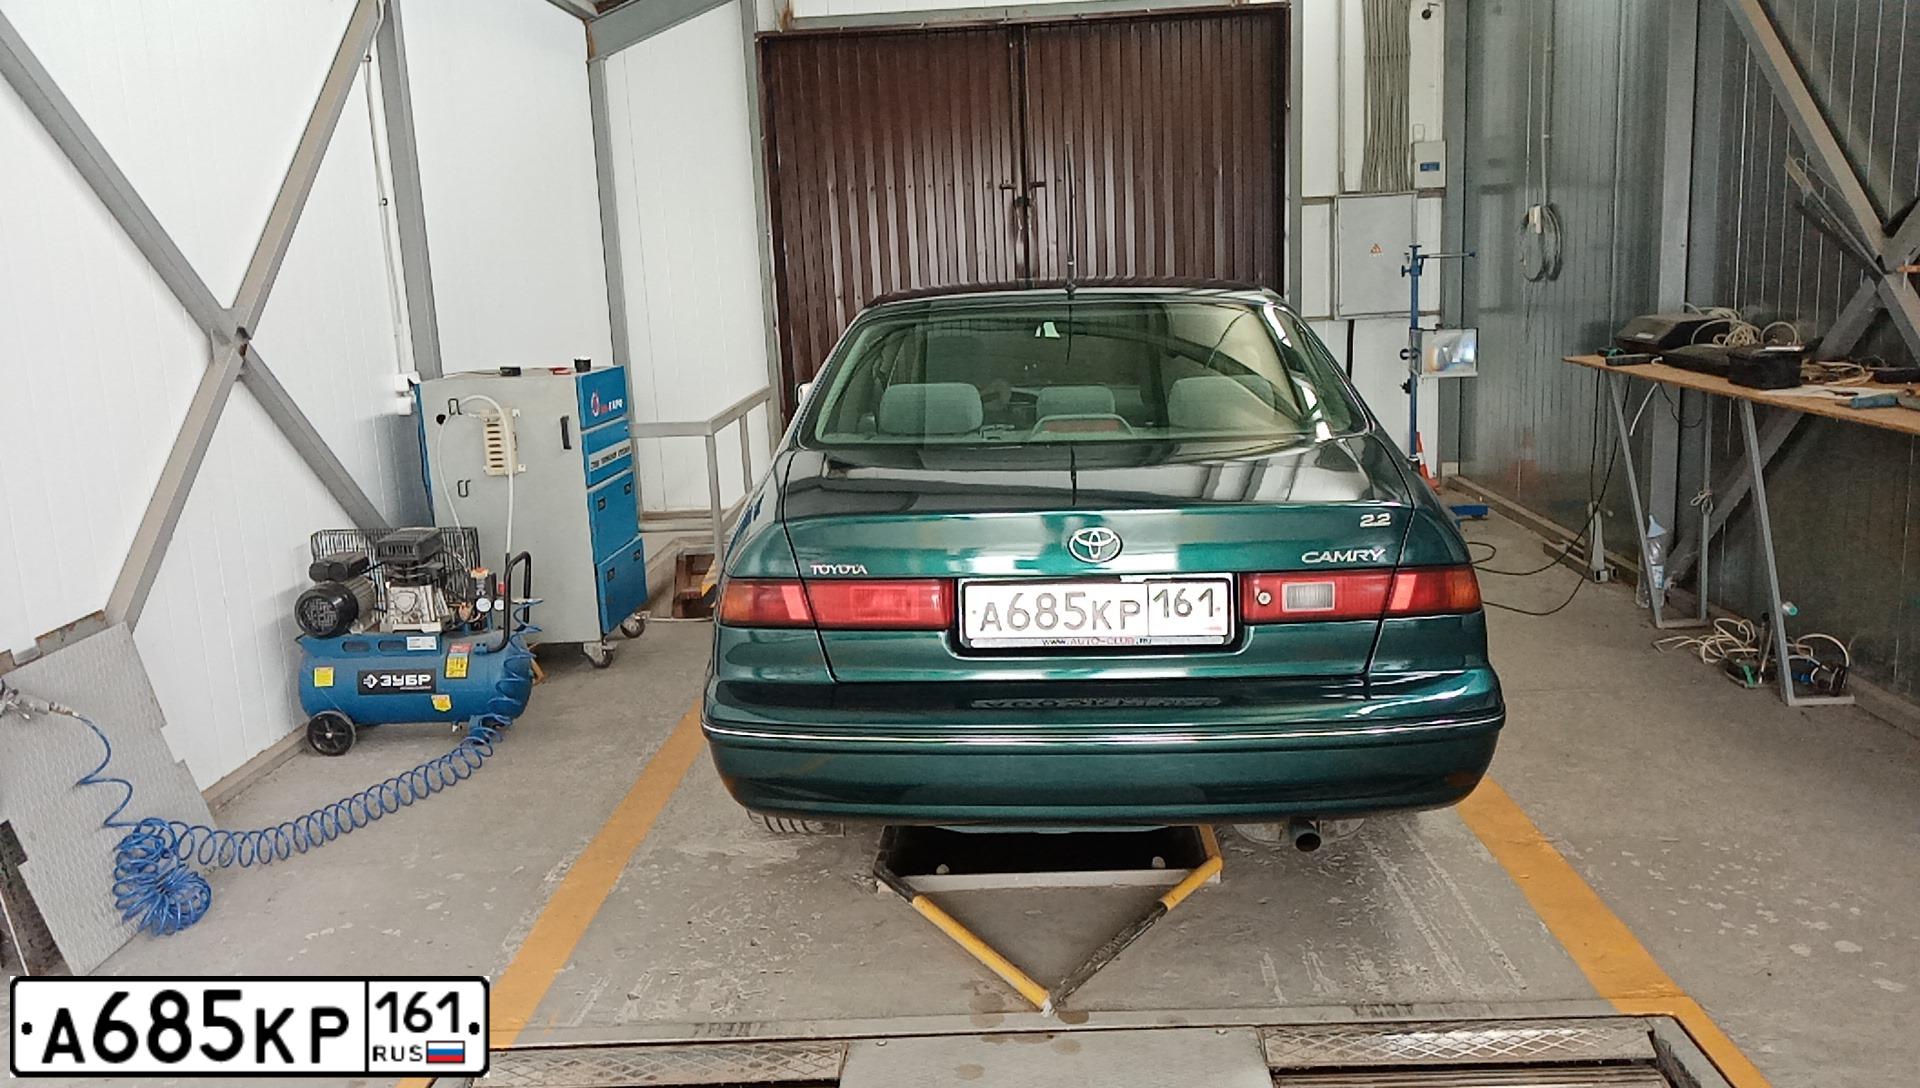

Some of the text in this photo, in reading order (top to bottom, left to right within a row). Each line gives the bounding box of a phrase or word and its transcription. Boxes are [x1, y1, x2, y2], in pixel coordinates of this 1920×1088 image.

[1301, 549, 1386, 563] CAMRY
[810, 564, 868, 575] TOYOTA
[980, 588, 1213, 631] А685КР 161
[380, 674, 432, 687] ЗУБР
